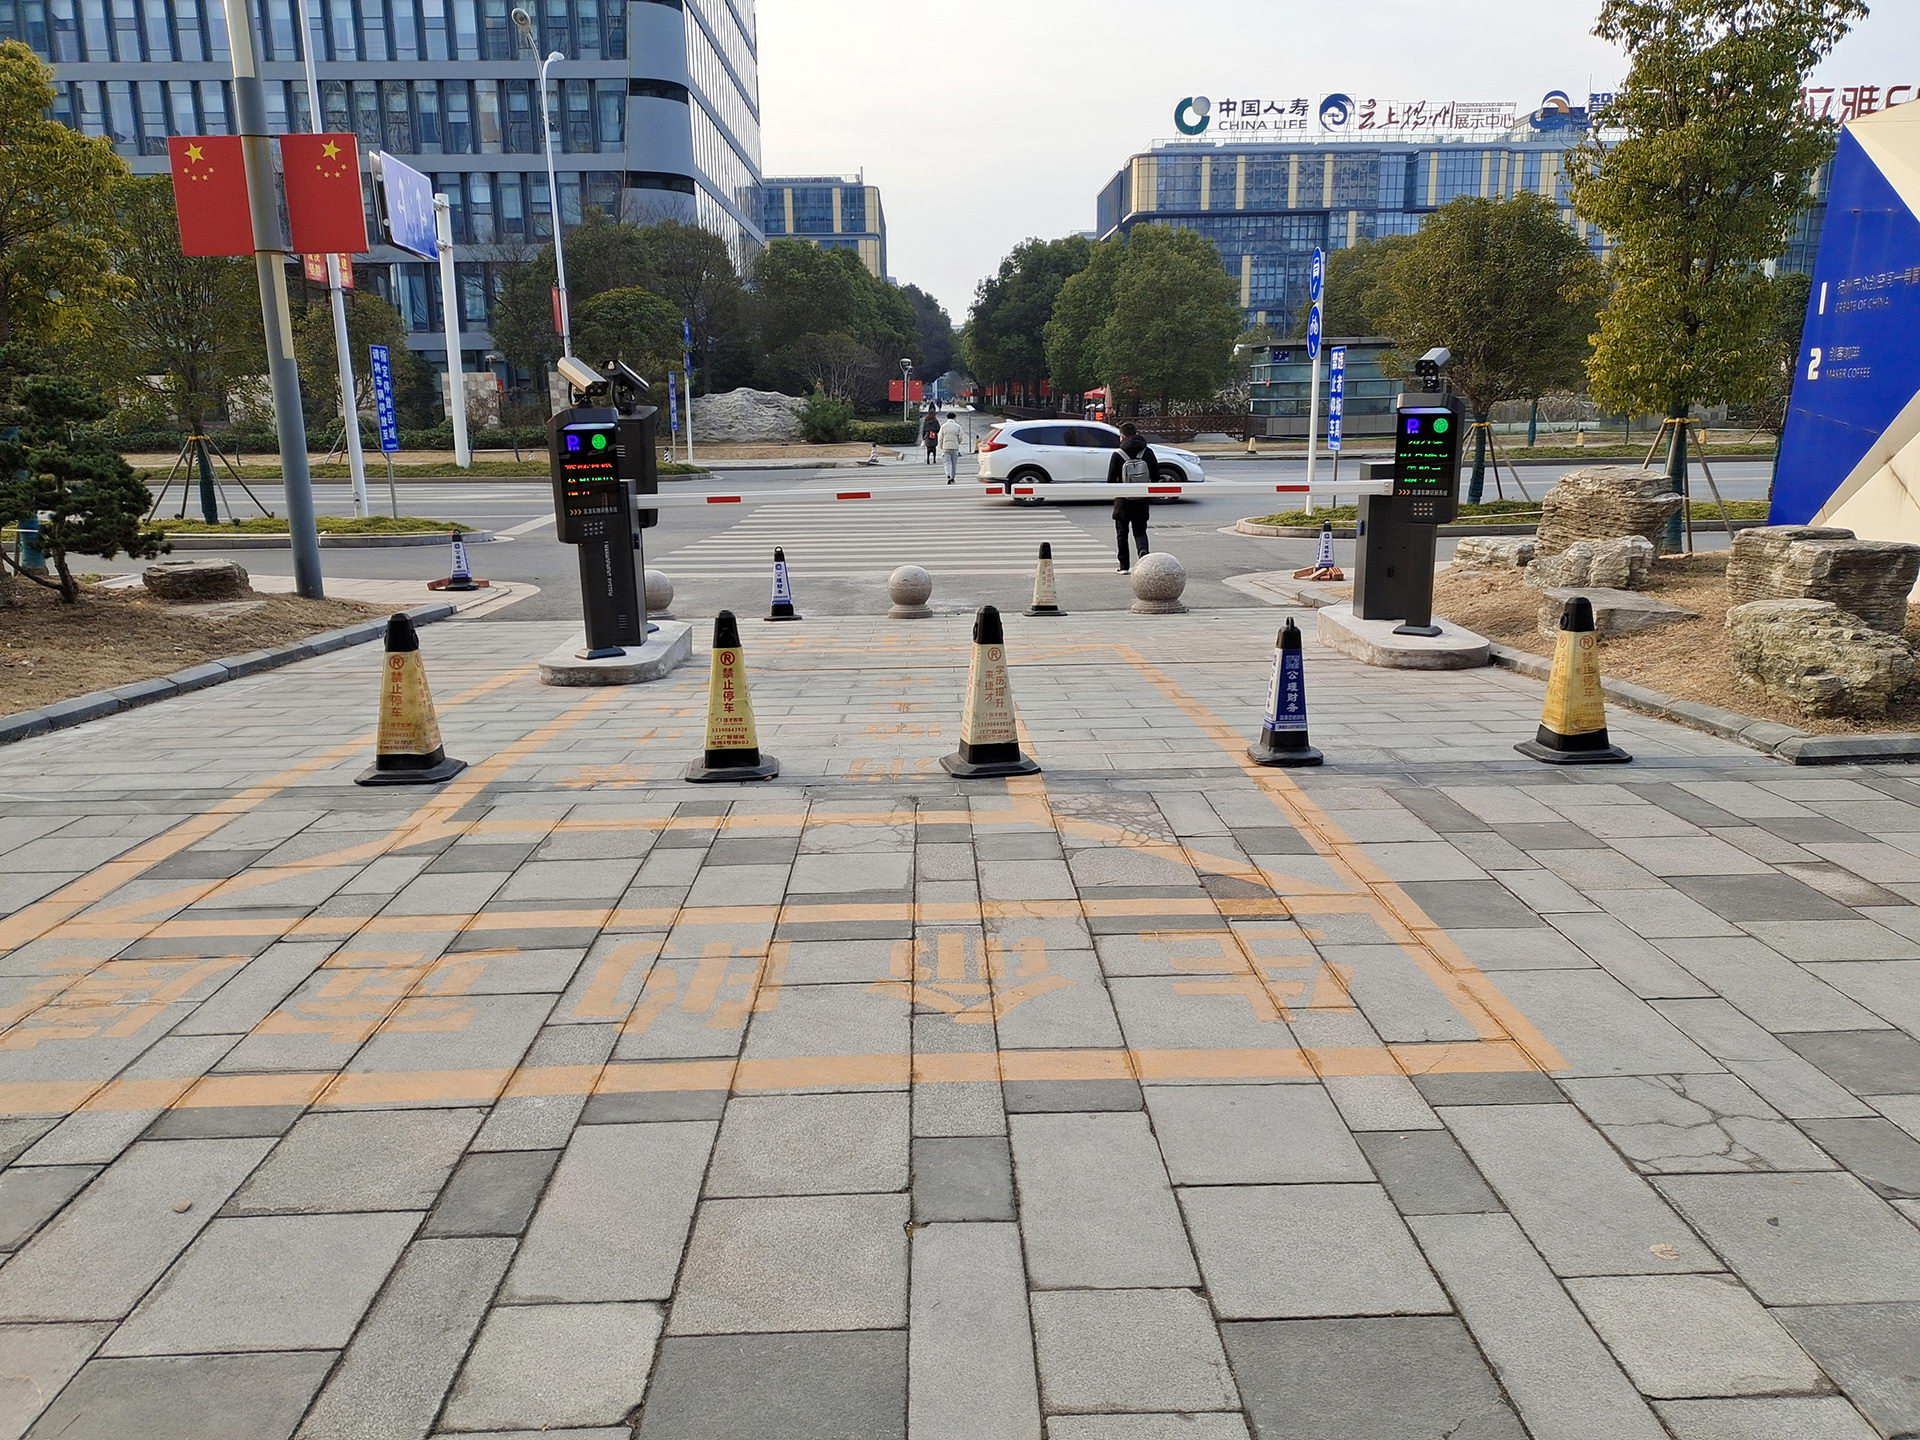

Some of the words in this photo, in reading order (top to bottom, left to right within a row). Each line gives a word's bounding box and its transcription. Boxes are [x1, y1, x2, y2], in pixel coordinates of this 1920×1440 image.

[1218, 98, 1309, 117] 中国人寿
[1359, 98, 1455, 131] 云上扬州
[1455, 114, 1516, 130] 展示中心
[1218, 120, 1267, 130] CHINA
[1274, 119, 1308, 130] LIFE
[1867, 296, 1889, 309] CHINA
[1807, 347, 1822, 380] 2
[1826, 368, 1846, 379] MAKER
[1847, 367, 1871, 378] COFFEE
[372, 349, 389, 440] 请将车辆停放至
[380, 349, 396, 440] 指定停放区域
[1329, 351, 1338, 437] 禁止停车
[722, 668, 735, 714] 禁止停车
[984, 671, 994, 704] 来捷才
[995, 665, 1005, 708] 学历提升
[1583, 652, 1595, 698] 禁止停车
[390, 671, 403, 718] 禁止停车
